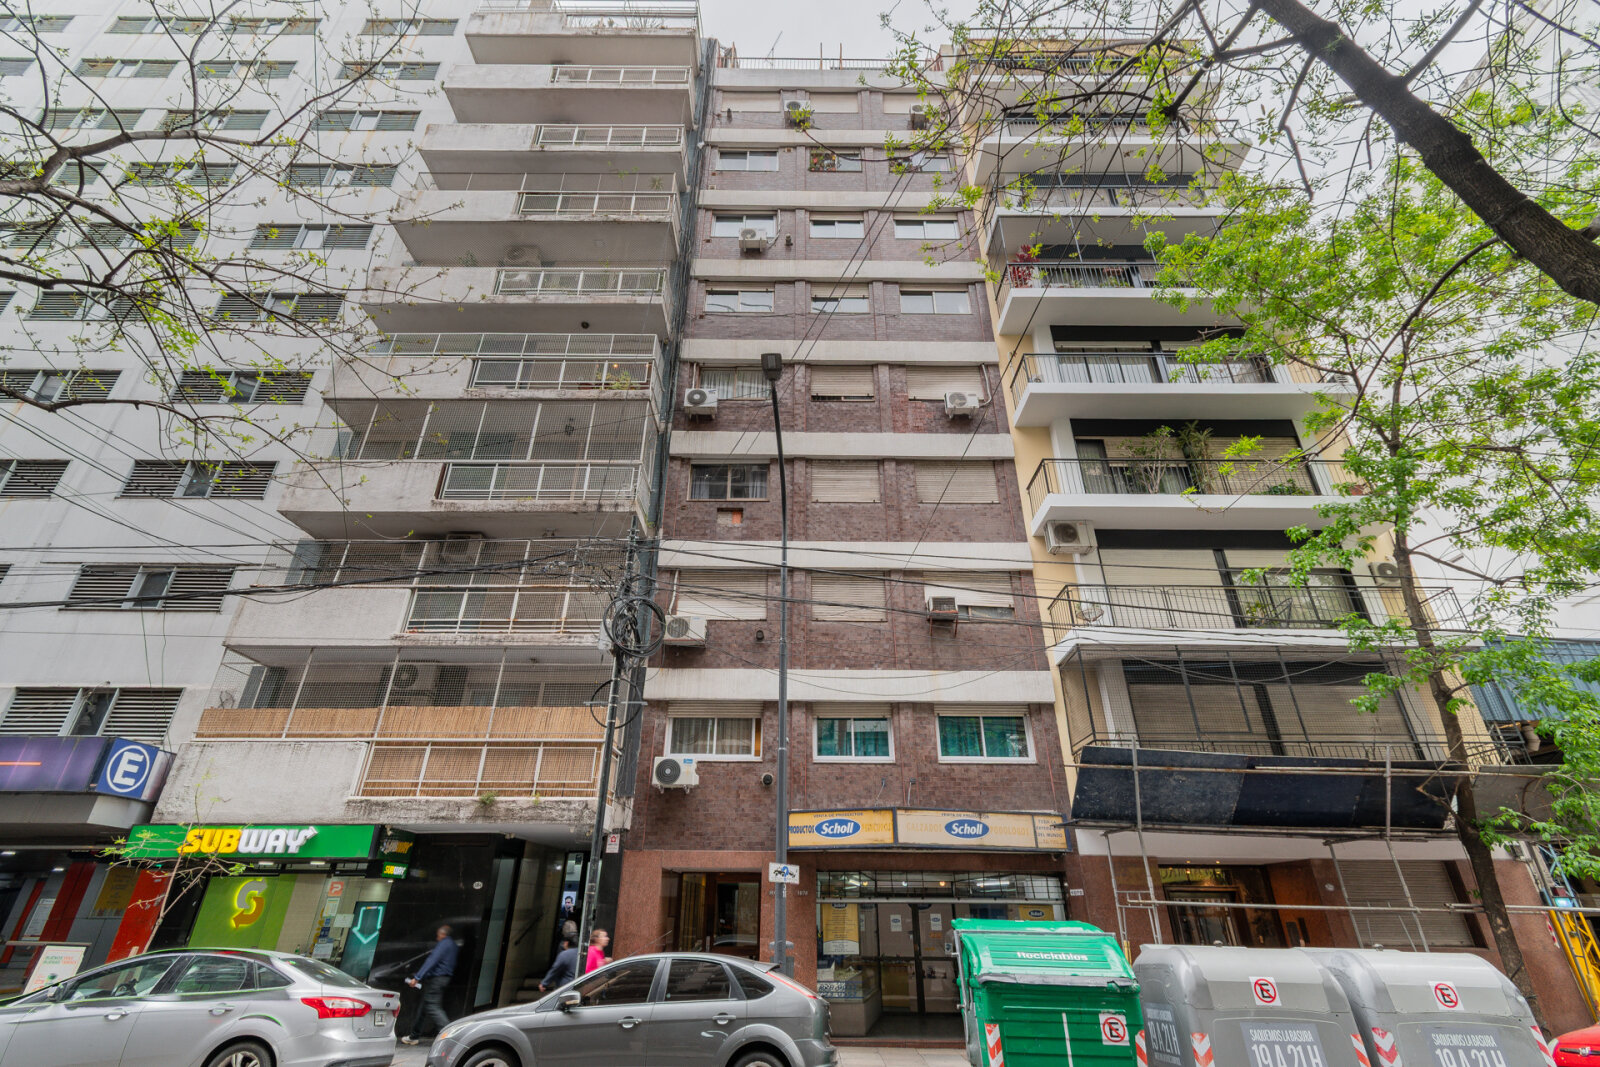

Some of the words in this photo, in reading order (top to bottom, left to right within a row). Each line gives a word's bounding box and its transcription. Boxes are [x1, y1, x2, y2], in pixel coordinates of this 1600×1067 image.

[113, 751, 144, 786] E
[821, 822, 854, 834] Scholl
[951, 823, 983, 835] Scholl
[177, 826, 318, 854] SUBWAY
[1252, 1044, 1273, 1067] 19
